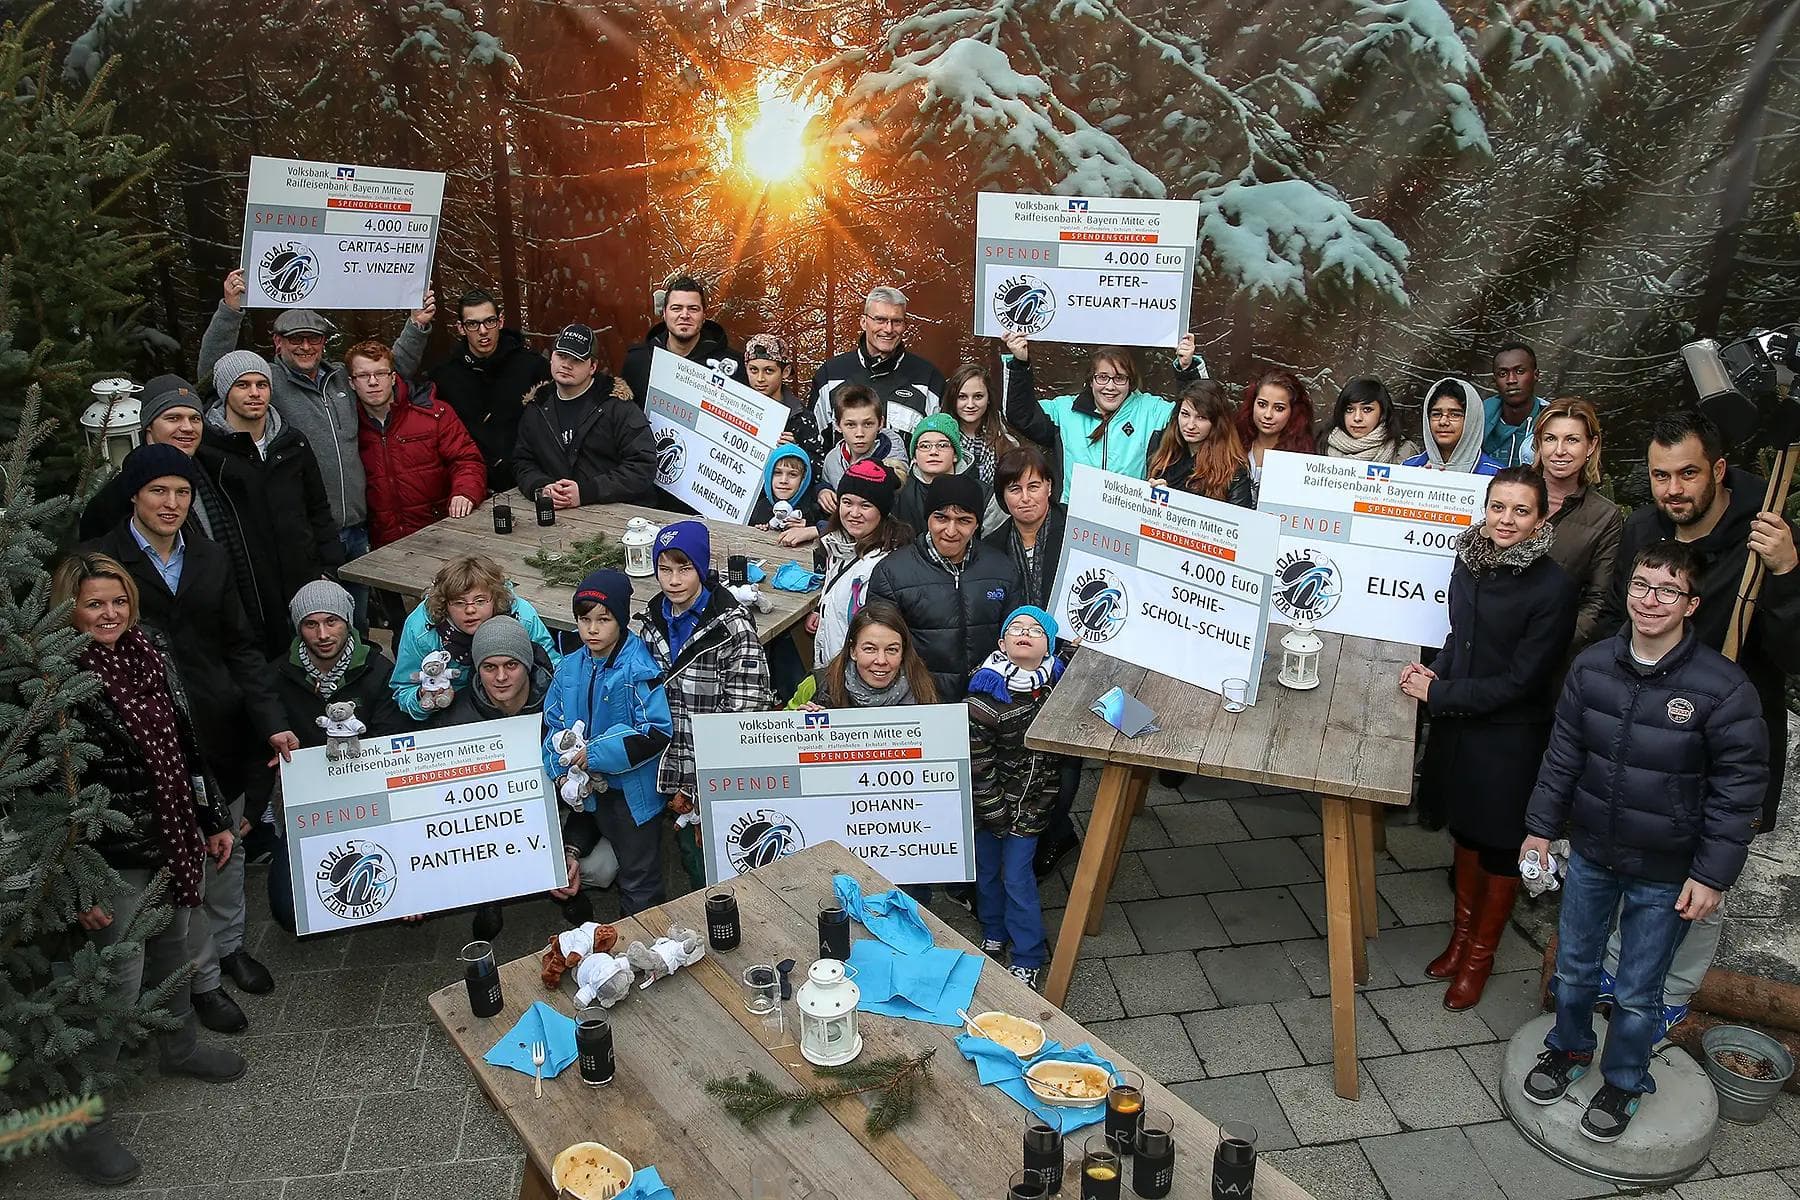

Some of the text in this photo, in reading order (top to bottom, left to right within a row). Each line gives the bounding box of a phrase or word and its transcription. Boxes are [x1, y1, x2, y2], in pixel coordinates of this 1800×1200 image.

[287, 166, 330, 178] Volksbank
[286, 178, 414, 196] Raiffeisenbank Bayern Mitte eG
[338, 200, 402, 210] SPENDENSCHECK
[1014, 201, 1060, 211] Volksbank
[255, 212, 318, 228] SPENDE
[364, 219, 428, 233] 4.000 Euro
[1014, 212, 1160, 228] Raiffeisenbank Bayern Mitte eG
[338, 240, 424, 254] CARITAS-HEIM
[1071, 232, 1147, 242] SPENDENSCHECK
[260, 241, 295, 269] GOALS
[985, 246, 1050, 261] SPENDE
[1104, 251, 1182, 265] 4.000 Euro
[343, 262, 416, 274] ST. VINZENZ
[260, 280, 305, 302] FOR KIDS
[994, 274, 1027, 301] GOALS
[1099, 275, 1148, 288] PETER-
[1067, 295, 1177, 310] STEUART-HAUS
[996, 311, 1042, 333] FOR KIDS
[652, 395, 694, 423] SPENDE
[654, 428, 675, 442] OALS
[722, 431, 766, 462] 4.000 Euro
[709, 447, 746, 475] CARITAS-
[1305, 462, 1357, 478] Volksbank
[697, 462, 747, 499] KINDERDORF
[1103, 479, 1143, 499] Volksbank
[1303, 476, 1475, 506] Raiffeisenbank Bayern Mitte eG
[691, 481, 740, 520] MARIENSTEIN
[1102, 493, 1162, 519] Raiffeisenbank
[1166, 510, 1197, 528] Bayern
[1199, 520, 1223, 536] Mitte
[1226, 529, 1239, 540] eG
[1268, 512, 1342, 534] PENDE
[1367, 504, 1458, 523] SPENDENSCHECK
[1072, 527, 1132, 557] SPENDE
[1151, 528, 1225, 557] SPENDENSCHECK
[1404, 529, 1457, 550] 4.000
[1274, 549, 1311, 578] GOALS
[1071, 568, 1106, 595] GOALS
[1180, 560, 1259, 595] 4.000 Euro
[1367, 576, 1426, 601] ELISA
[1171, 585, 1225, 612] SOPHIE-
[1271, 591, 1322, 620] FOR KIDS
[1068, 608, 1108, 642] FOR KIDS
[1141, 602, 1251, 651] SCHOLL-SCHULE
[739, 718, 795, 731] Volksbank
[740, 726, 922, 745] Raiffeisenbank Bayern Mitte eG
[327, 739, 504, 778] Raiffeisenbank Bayern Mitte eG
[814, 749, 907, 761] SPENDENSCHECK
[401, 763, 493, 784] SPENDENSCHECK
[708, 775, 791, 792] SPENDE
[858, 769, 955, 787] 4.000 Euro
[444, 779, 539, 805] 4.000 Euro
[297, 802, 379, 829] SPENDE
[849, 798, 924, 815] JOHANN-
[426, 808, 525, 839] ROLLENDE
[726, 809, 766, 844] GOALS
[846, 820, 932, 836] NEPOMUK-
[316, 840, 356, 880] GOALS
[410, 834, 547, 871] PANTHER e. V.
[733, 858, 751, 874] FO
[321, 894, 384, 918] FOR KIDS
